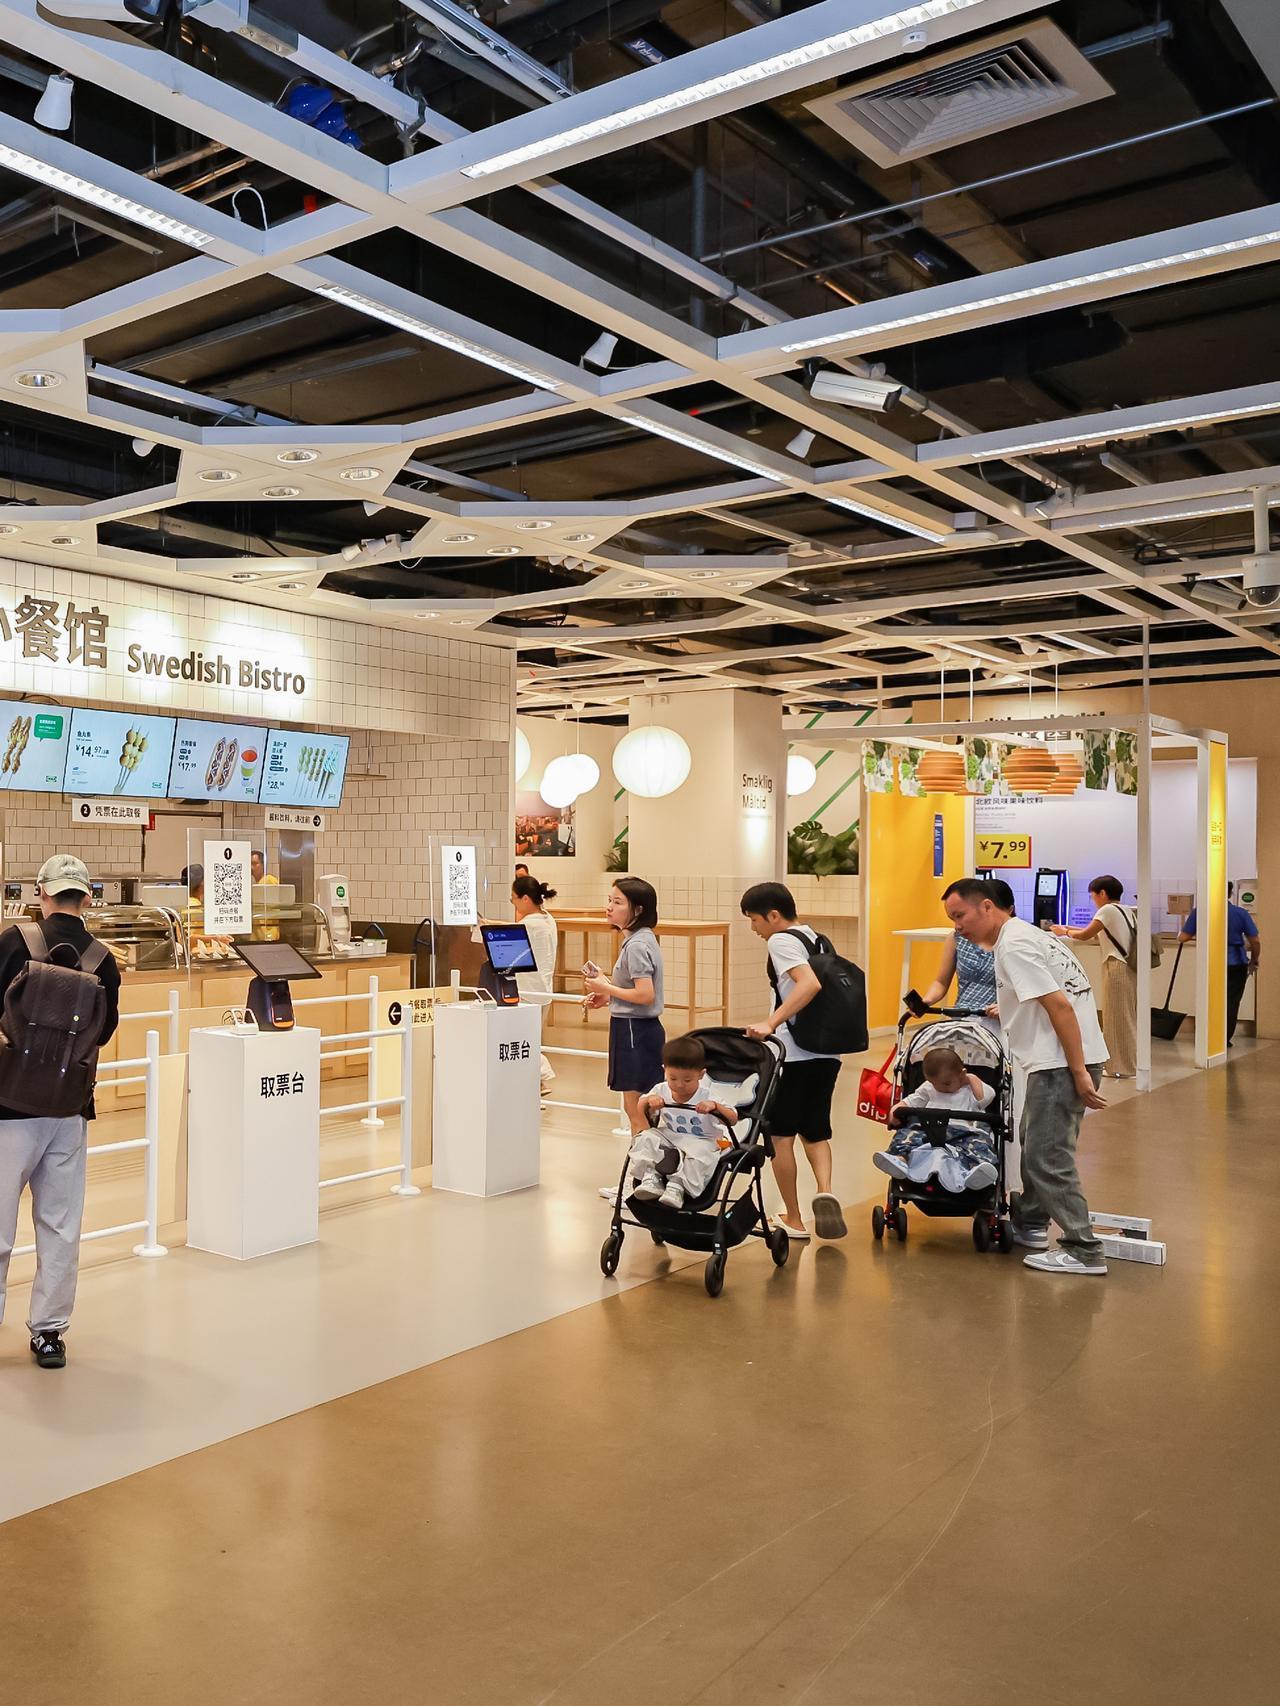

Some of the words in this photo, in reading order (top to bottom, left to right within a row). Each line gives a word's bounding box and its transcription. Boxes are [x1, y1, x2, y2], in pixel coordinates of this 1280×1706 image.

[127, 643, 231, 685] Swedish
[239, 660, 306, 695] Bistro
[742, 773, 773, 793] Smaklig
[95, 806, 141, 818] 凭票在此取餐
[979, 840, 1027, 859] ¥7.99
[411, 1012, 434, 1024] 此进入
[499, 1040, 531, 1062] 取票台
[261, 1071, 305, 1099] 取票台
